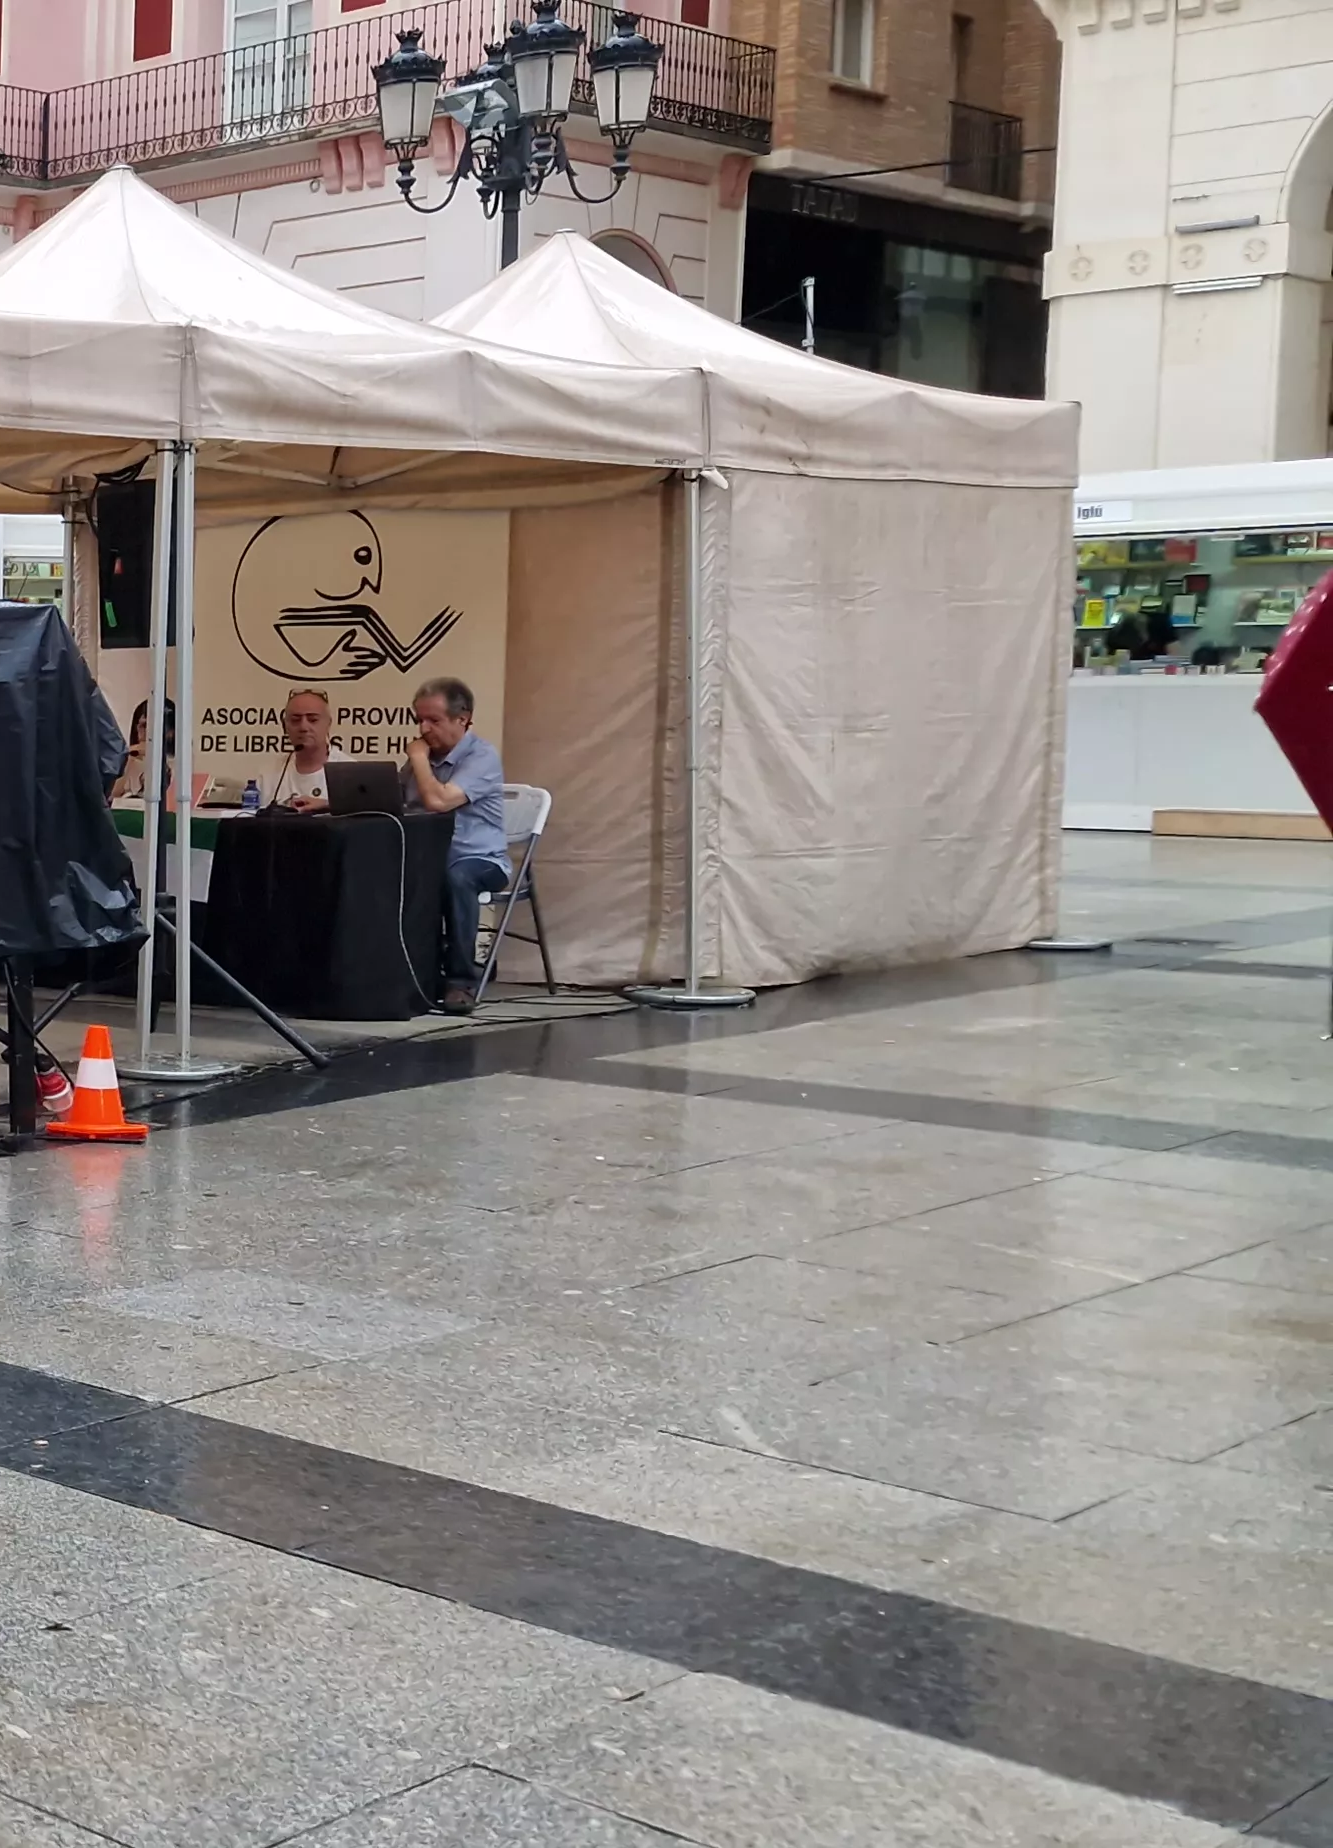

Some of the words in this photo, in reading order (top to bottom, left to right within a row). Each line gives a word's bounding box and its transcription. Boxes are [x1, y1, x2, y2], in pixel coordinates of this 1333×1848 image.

[200, 707, 286, 725] ASOCIA
[337, 707, 419, 725] PROVIN
[200, 735, 228, 752] DE
[233, 735, 343, 752] LIBRES
[350, 736, 379, 754] DE
